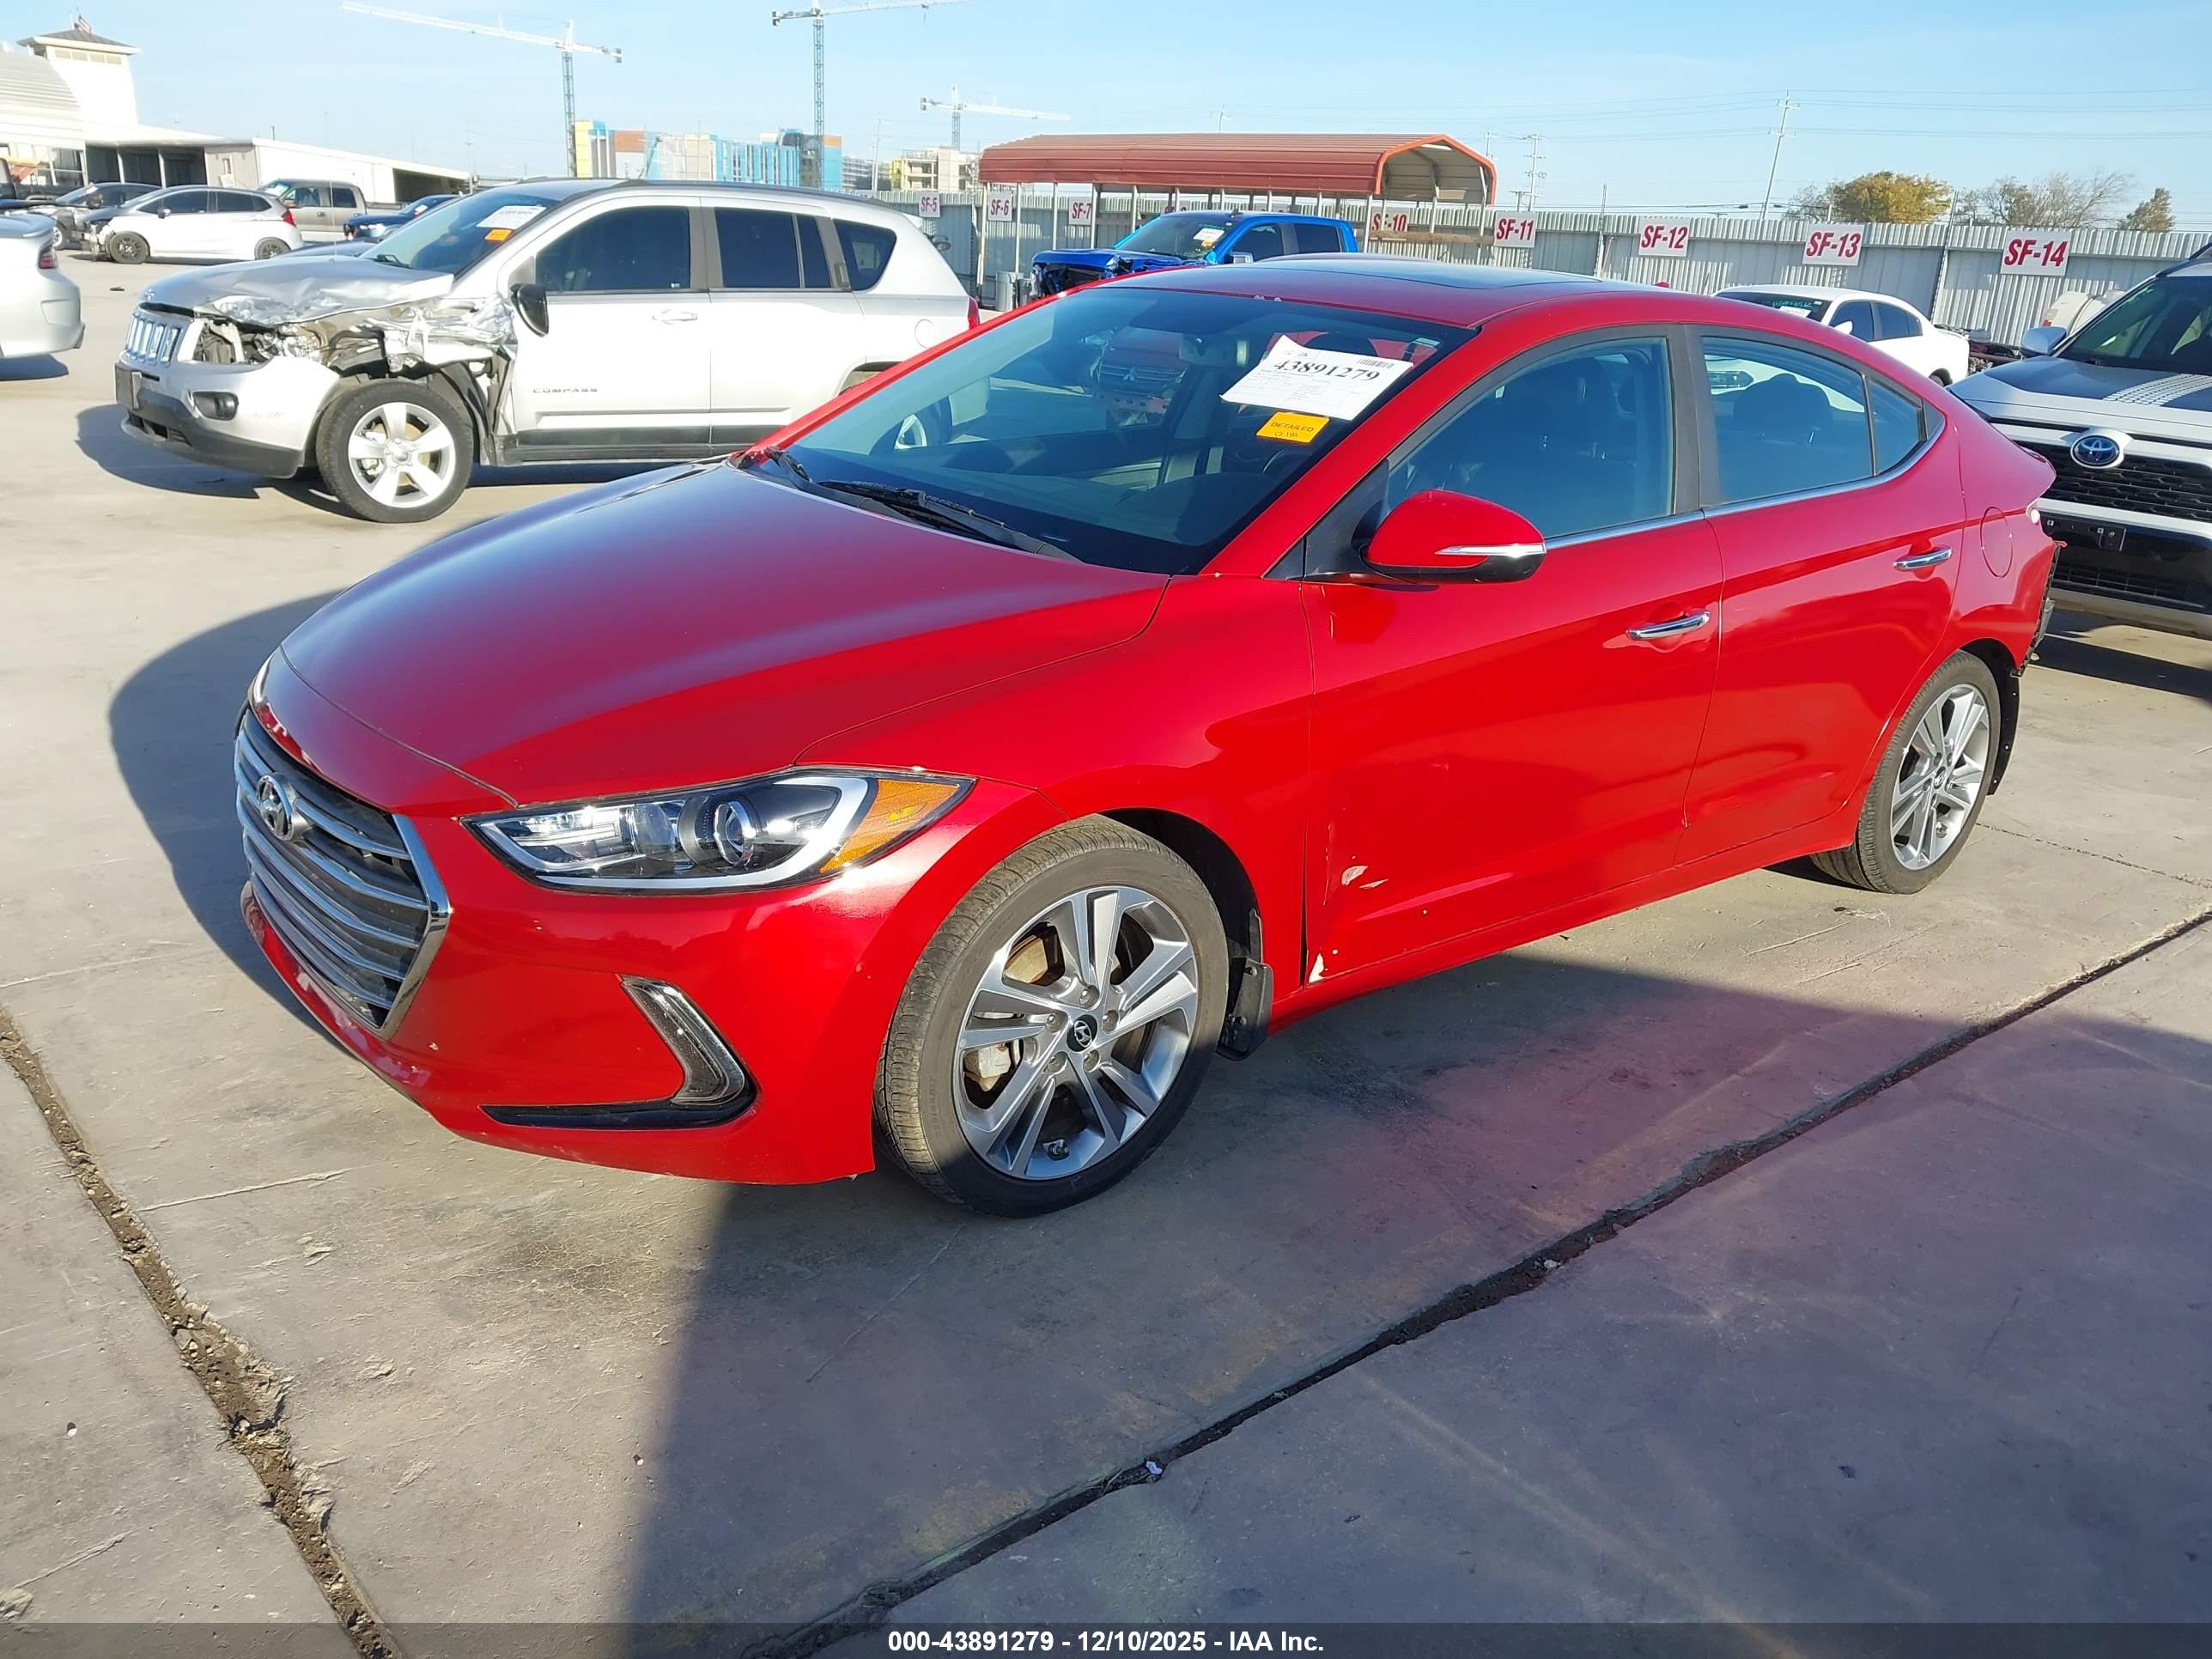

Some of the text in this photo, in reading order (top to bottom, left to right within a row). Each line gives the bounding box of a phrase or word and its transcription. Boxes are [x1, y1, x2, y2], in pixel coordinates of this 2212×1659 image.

[921, 197, 938, 212] SF-5
[990, 198, 1009, 216] SF-6
[1072, 203, 1092, 219] SF-7
[1496, 218, 1534, 241] SF-11
[1641, 225, 1688, 249] SF-12
[1806, 231, 1862, 258] SF-13
[2004, 239, 2068, 267] SF-14
[1273, 360, 1380, 381] 43891279
[1270, 422, 1315, 433] DETAILED
